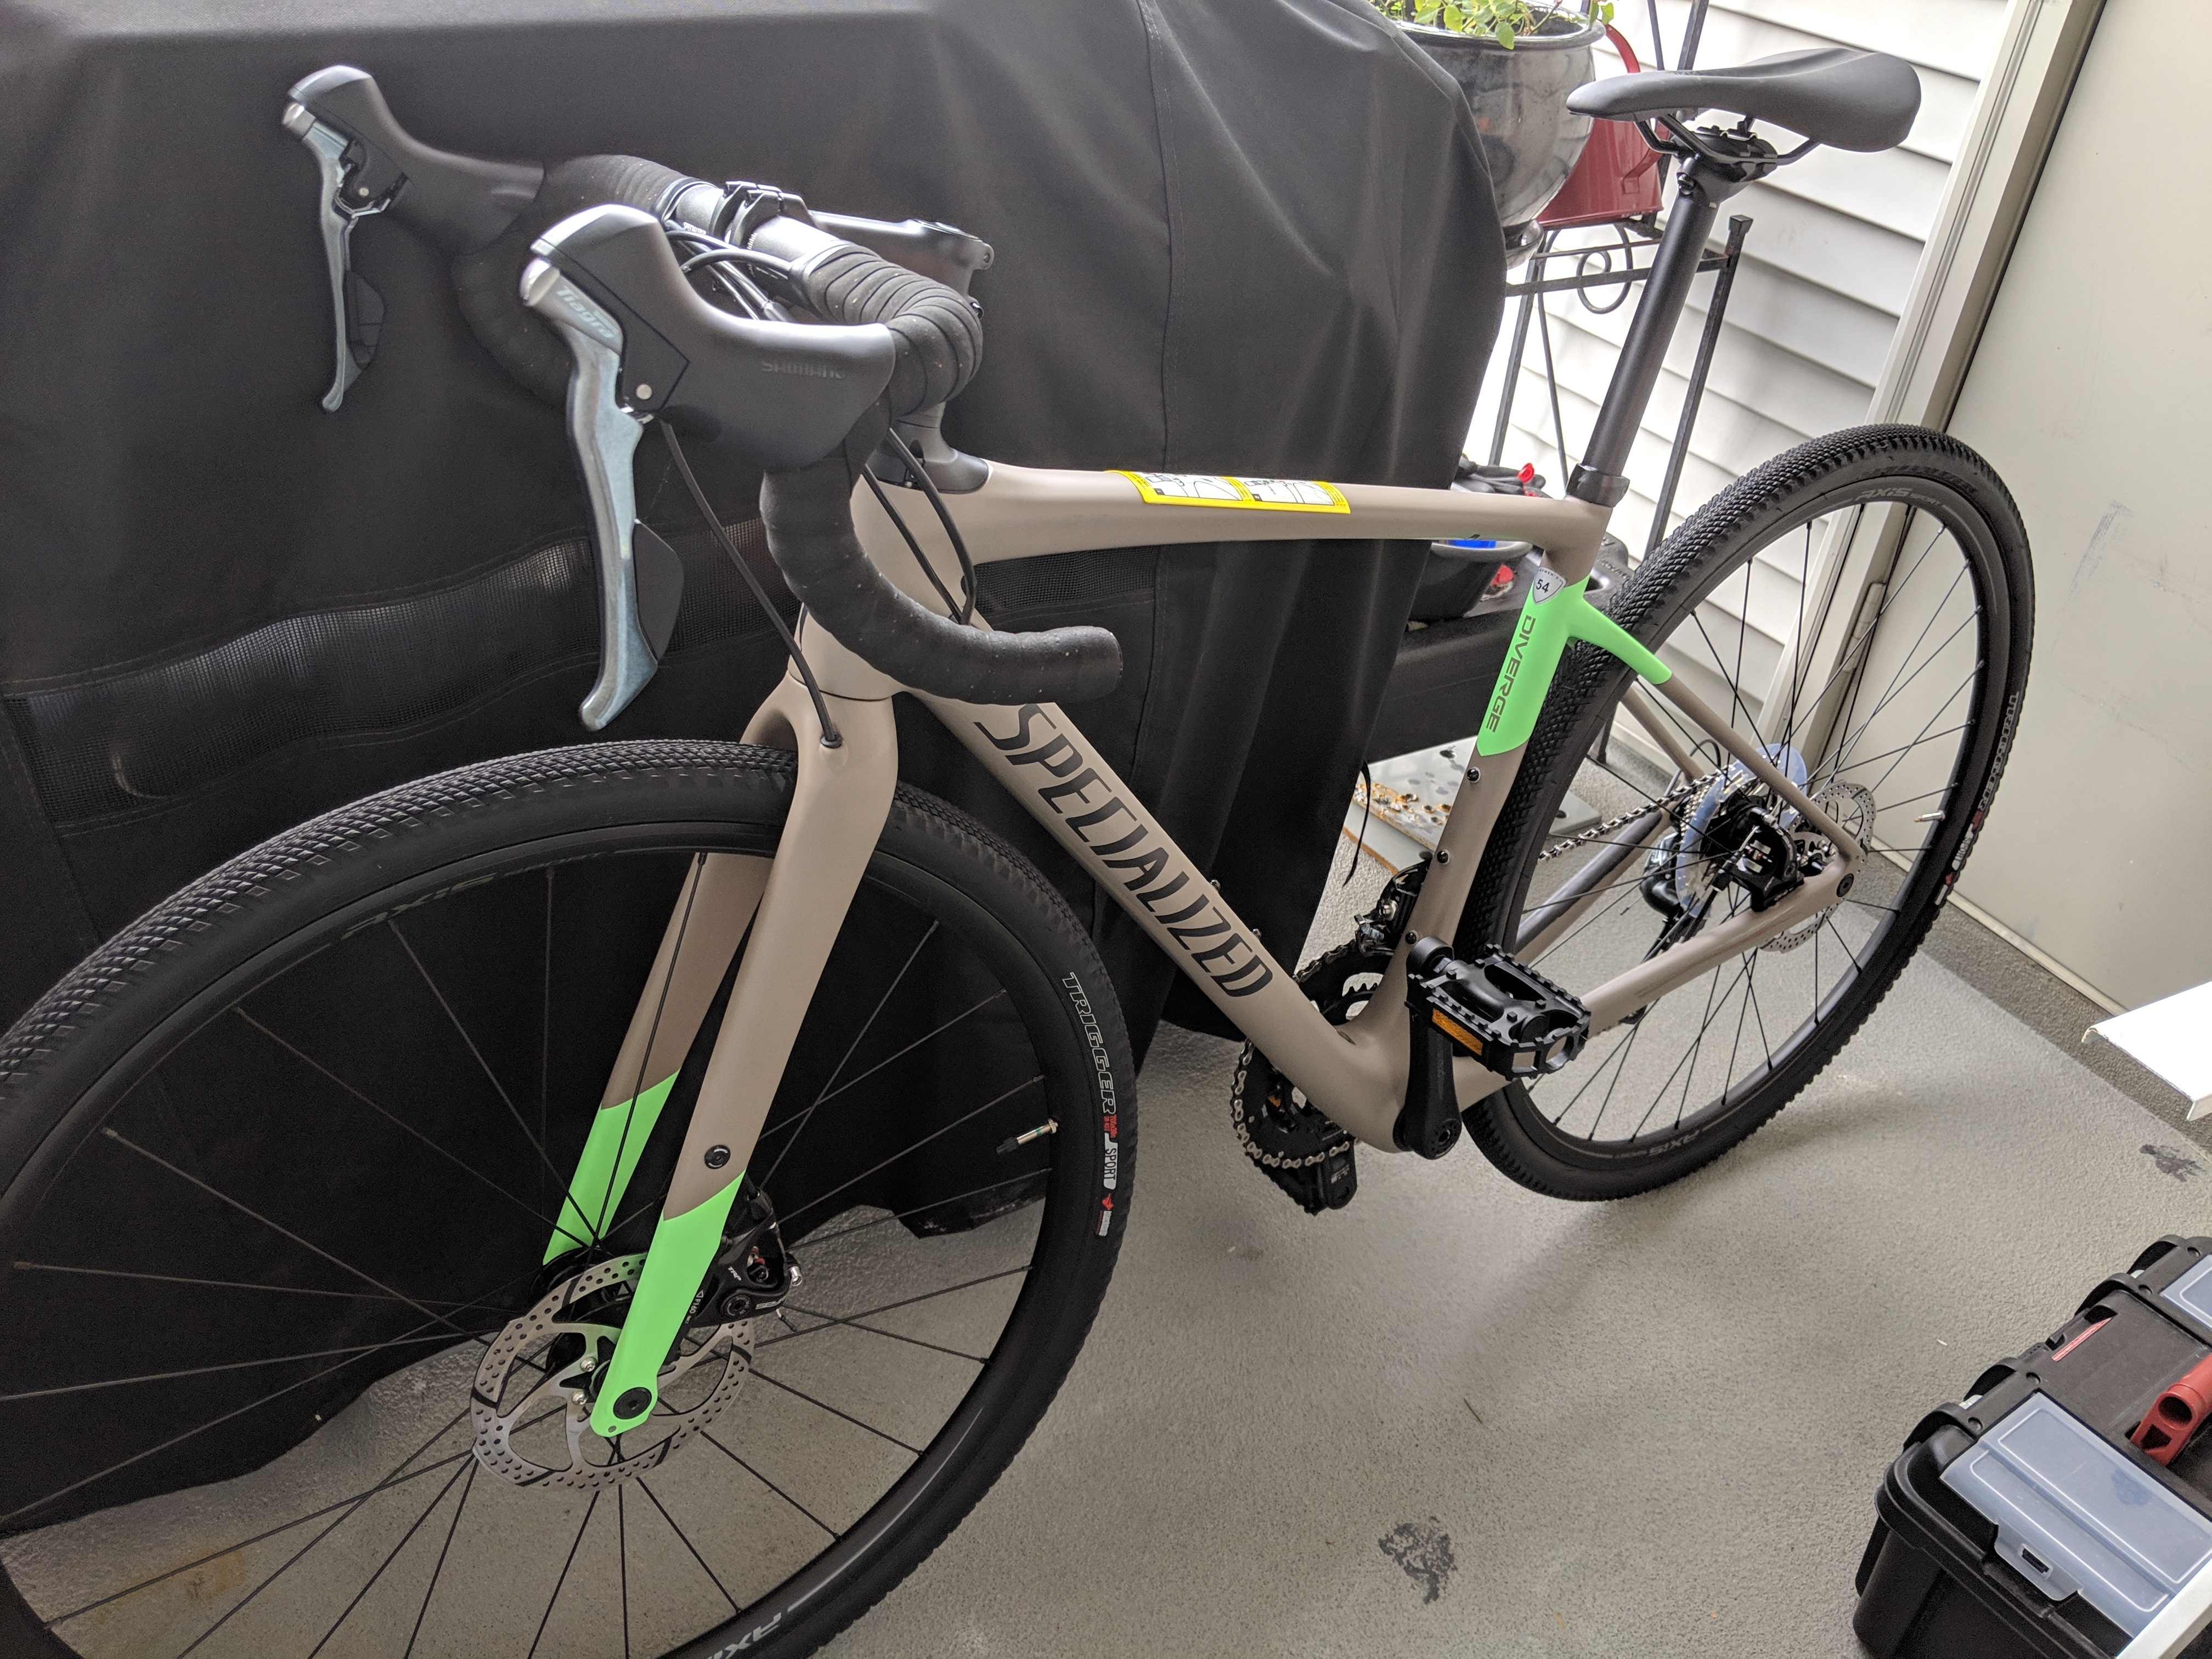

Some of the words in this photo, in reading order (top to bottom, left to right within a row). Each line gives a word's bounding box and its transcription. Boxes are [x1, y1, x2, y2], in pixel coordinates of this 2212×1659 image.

[556, 287, 613, 338] Tiagra
[1536, 579, 1549, 594] 54
[1486, 614, 1536, 733] DIVERGE
[973, 703, 1273, 997] SPECIALIZED
[1062, 972, 1117, 1115] TRIGGER
[1104, 1147, 1117, 1181] SPORT
